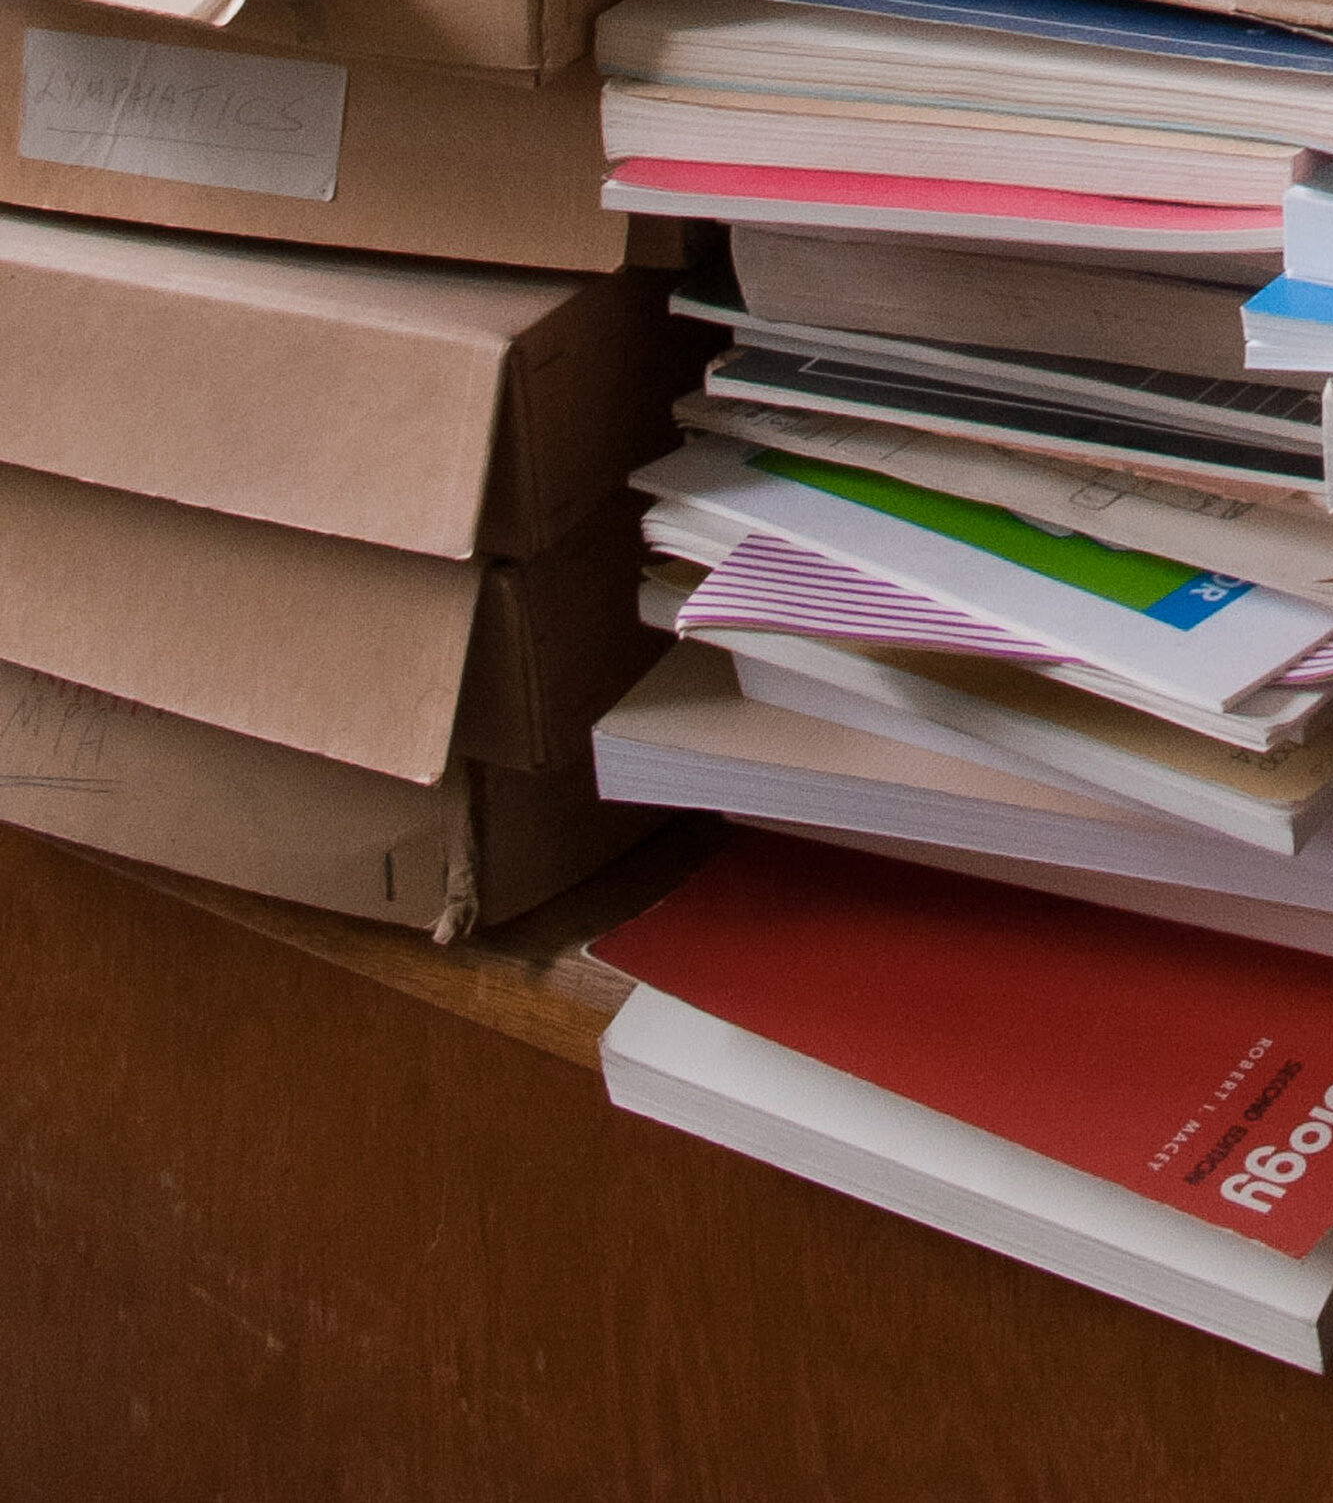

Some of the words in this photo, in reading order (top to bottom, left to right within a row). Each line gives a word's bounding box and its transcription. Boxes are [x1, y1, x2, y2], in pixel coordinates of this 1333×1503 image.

[35, 70, 306, 135] LYMPHATICS
[1214, 1036, 1274, 1101] ROBERT
[1146, 1118, 1201, 1172] MACEY
